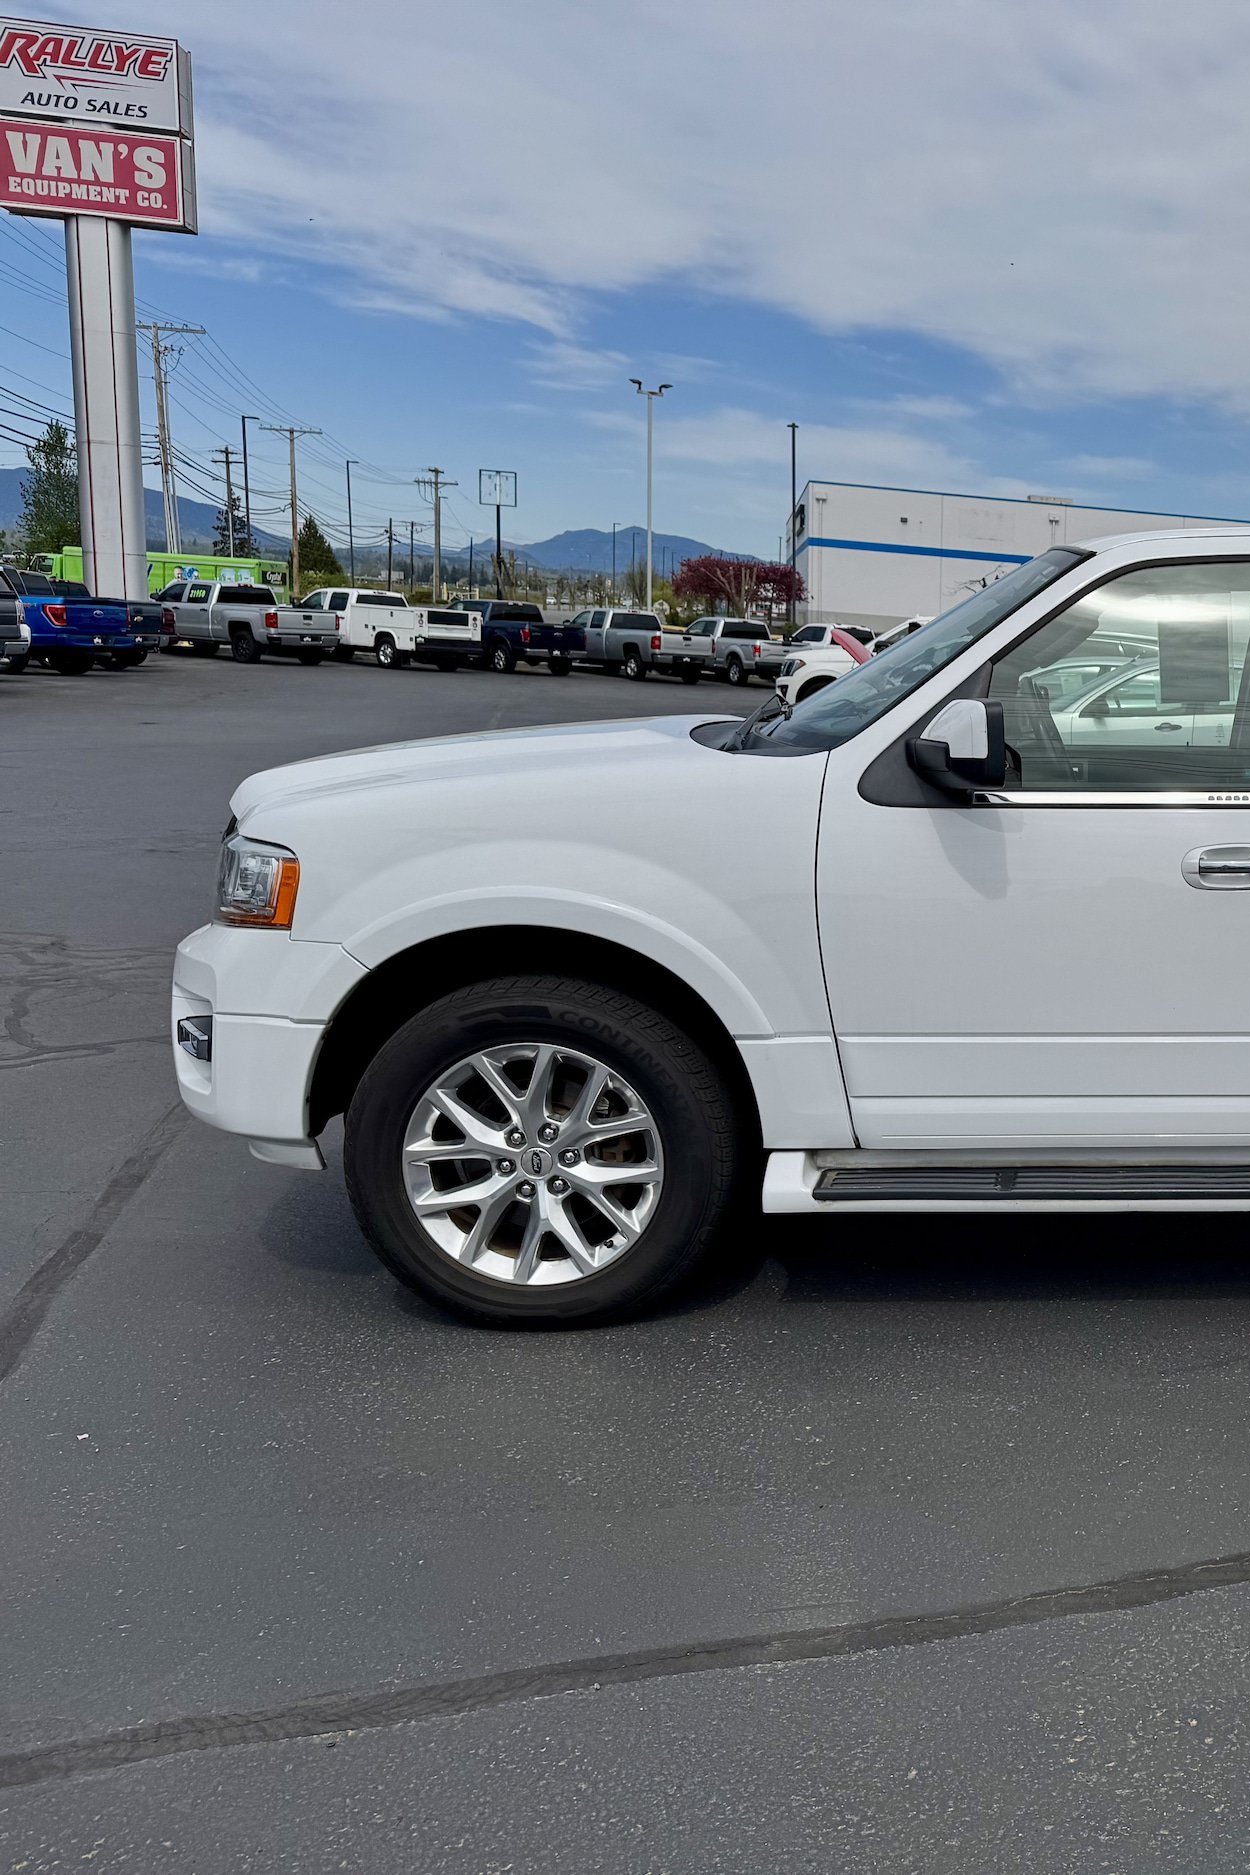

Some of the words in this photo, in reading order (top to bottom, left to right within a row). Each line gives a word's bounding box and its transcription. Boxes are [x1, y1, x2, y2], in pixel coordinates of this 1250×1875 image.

[0, 28, 174, 80] RALLYE
[21, 92, 78, 110] AUTO
[85, 99, 148, 118] SALES
[5, 130, 167, 189] VAN'S
[8, 176, 130, 205] EQUIPMENT
[136, 191, 168, 210] CO.
